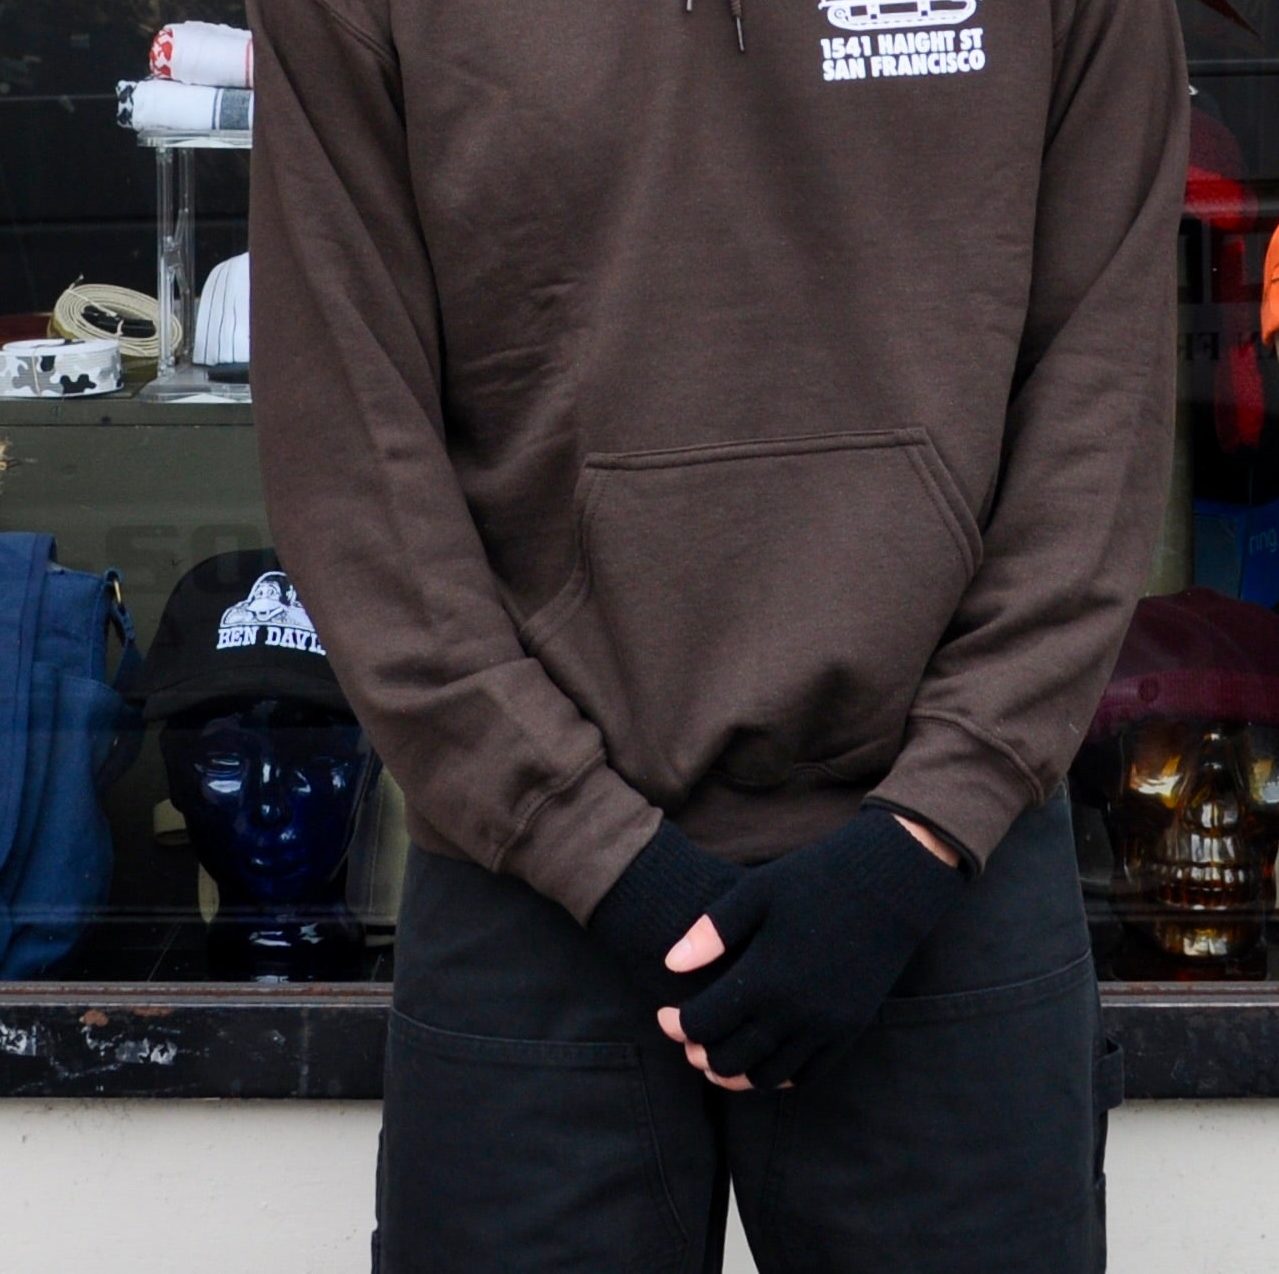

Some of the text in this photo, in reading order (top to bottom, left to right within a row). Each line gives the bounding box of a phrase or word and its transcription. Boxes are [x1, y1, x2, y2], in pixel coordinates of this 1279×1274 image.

[820, 28, 984, 59] 1541 HAIGHT ST
[822, 49, 986, 81] SAN FRANCISCO
[216, 626, 259, 650] BEN
